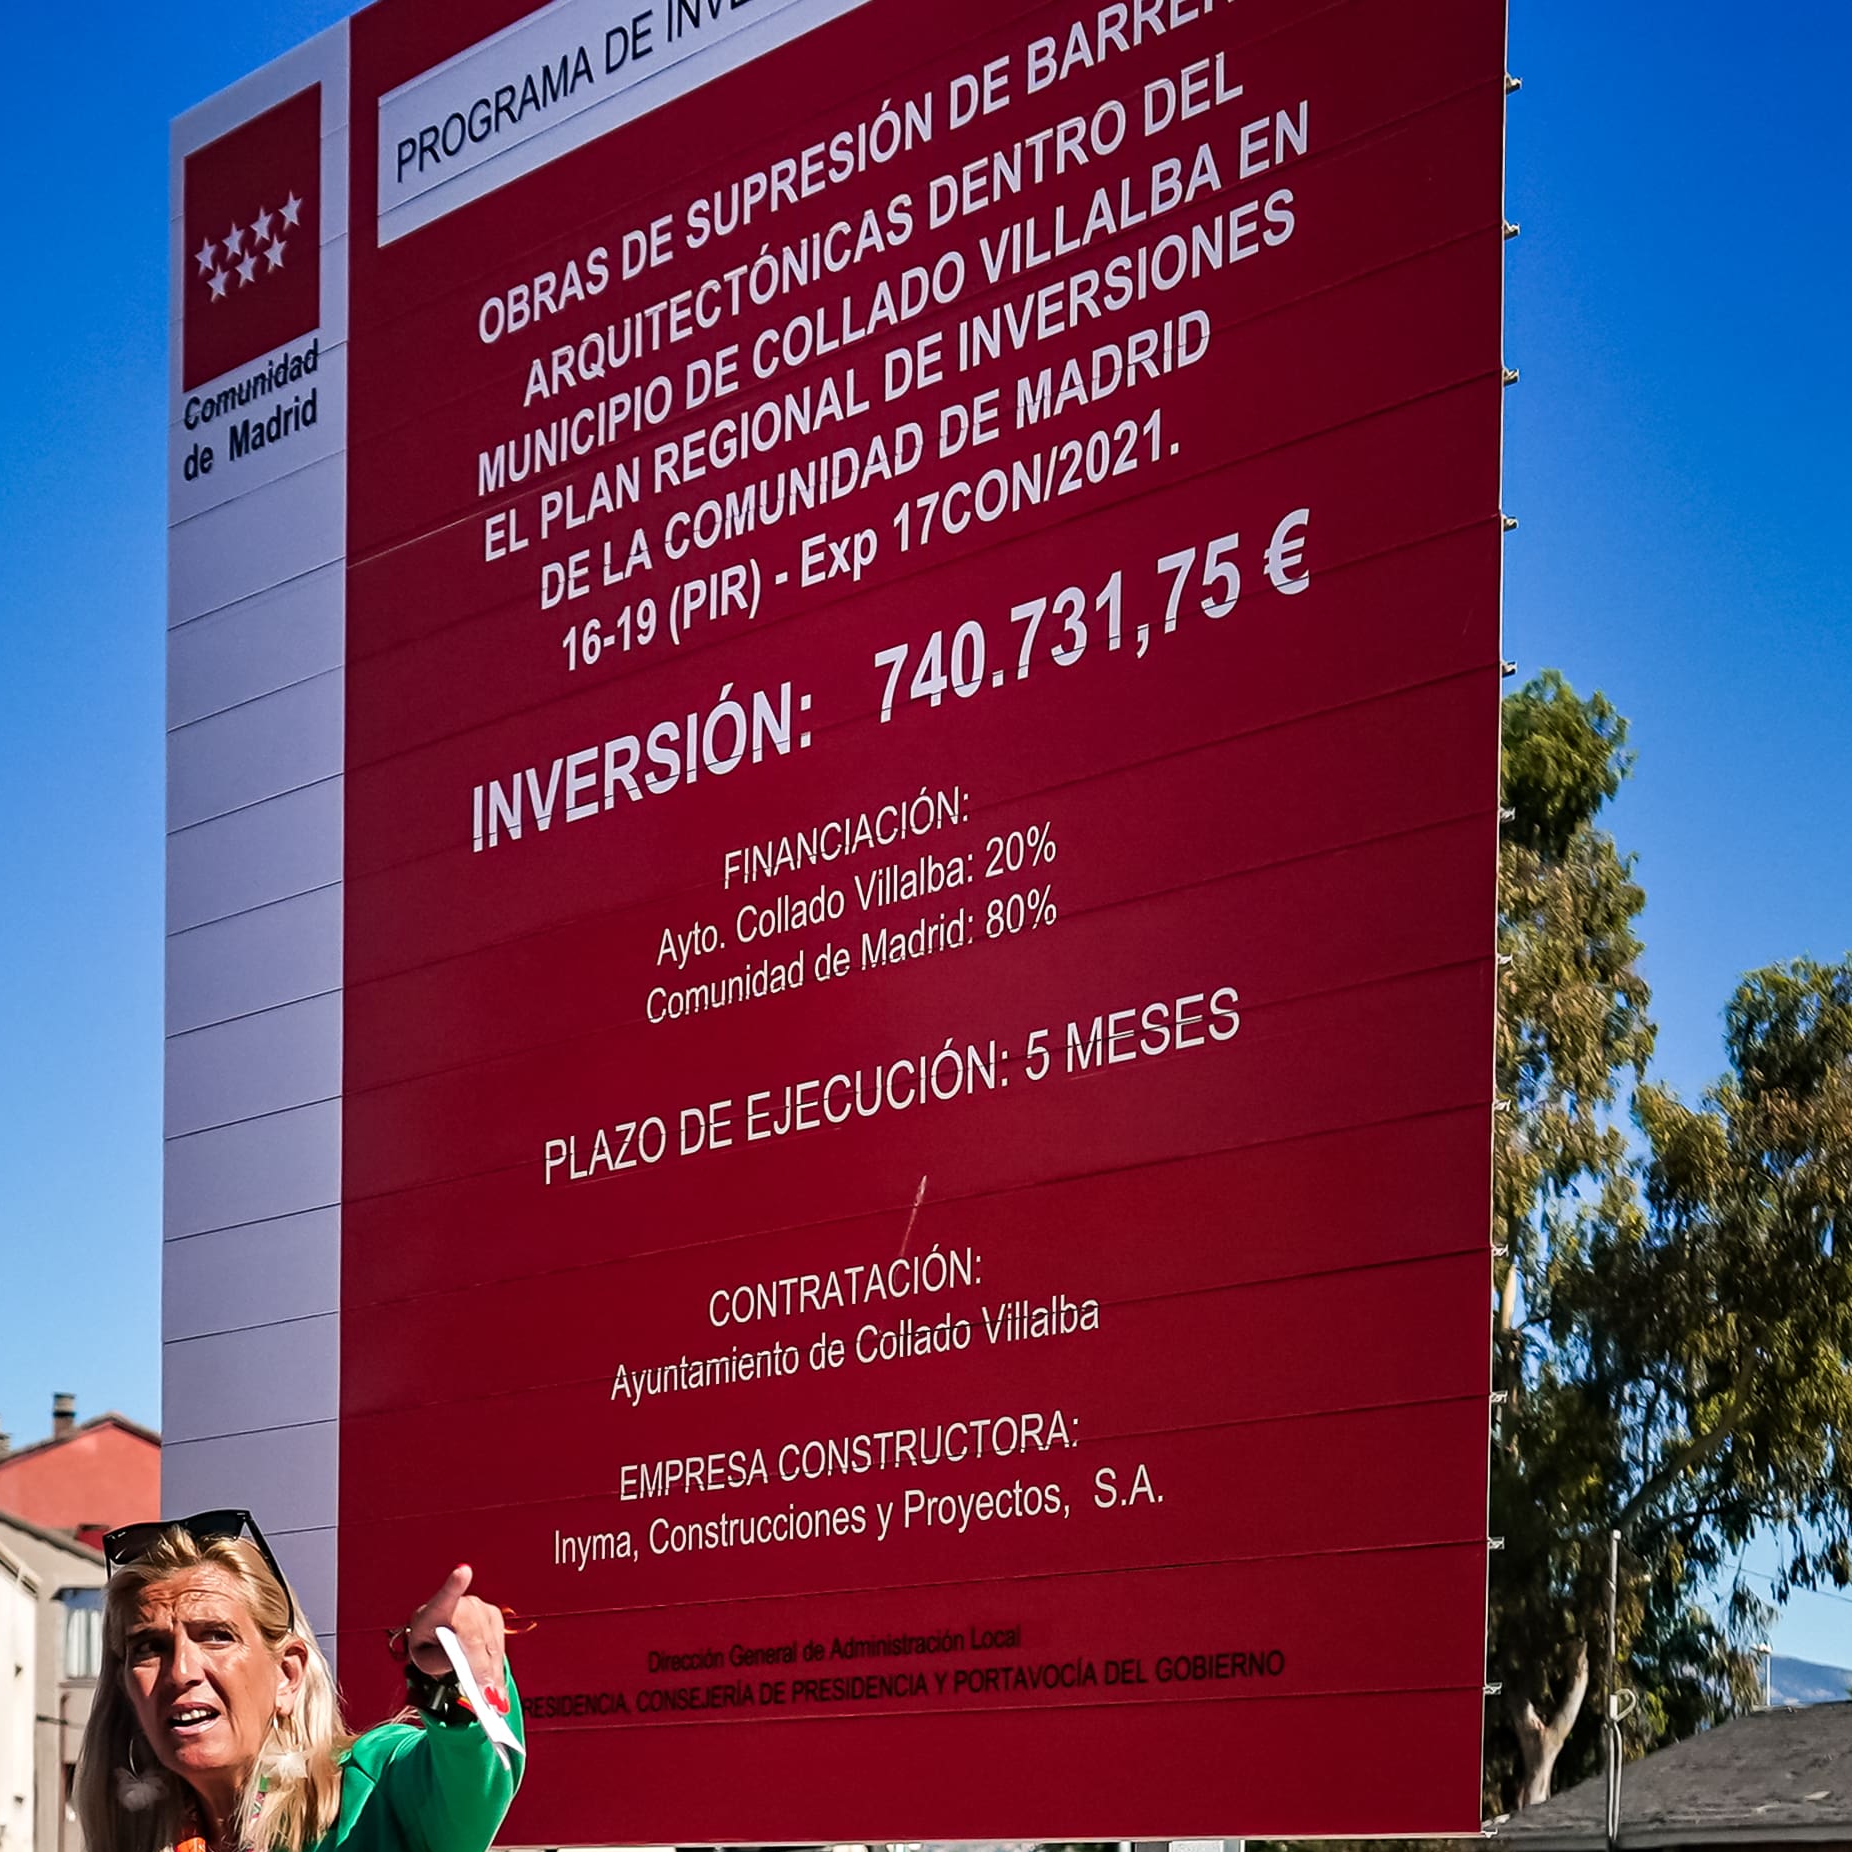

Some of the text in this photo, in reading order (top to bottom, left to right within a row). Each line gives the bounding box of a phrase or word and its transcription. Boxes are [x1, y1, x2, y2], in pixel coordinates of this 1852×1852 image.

[397, 0, 754, 183] PROGRAMA DE IN
[479, 0, 1215, 344] OBRAS DE SUPRESIÓN DE BARRE
[524, 51, 1244, 406] ARQUITECTÓNICAS DENTRO DEL
[478, 101, 1309, 497] MUNICIPIO DE COLLADO VILLALBA EN
[183, 338, 319, 431] Comunidad
[183, 387, 317, 481] de Madrid
[485, 189, 1295, 562] EL PLAN REGIONAL DE INVERSIONES
[541, 309, 1211, 610] DE LA COMUNIDAD DE MADRID
[563, 409, 1180, 671] 16-19 (PIR) - Exp 17CON/2021.
[473, 508, 1309, 852] INVERSIÓN: 740.731,75 €
[657, 821, 1057, 970] Ayto. Collado Villalba: 20%
[724, 786, 969, 889] FINANCIACIÓN:
[647, 885, 1057, 1024] Comunidad de Madrid: 80%
[544, 987, 1241, 1185] PLAZO DE EJECUCIÓN: 5 MESES
[611, 1294, 1100, 1407] Ayuntamiento de Collado Villalba
[709, 1244, 982, 1328] CONTRATACIÓN:
[554, 1463, 1164, 1571] Inyma, Construcciones y Proyectos, S.A.
[620, 1410, 1079, 1501] EMPRESA CONSTRUCTORA:
[524, 1649, 1285, 1719] RESIDENCIA, CONSEJERÍA DE PRESIDENCIA Y PORTAVOCÍA DEL GOBIERNO
[649, 1624, 1021, 1674] Dirección General de Administración Local
